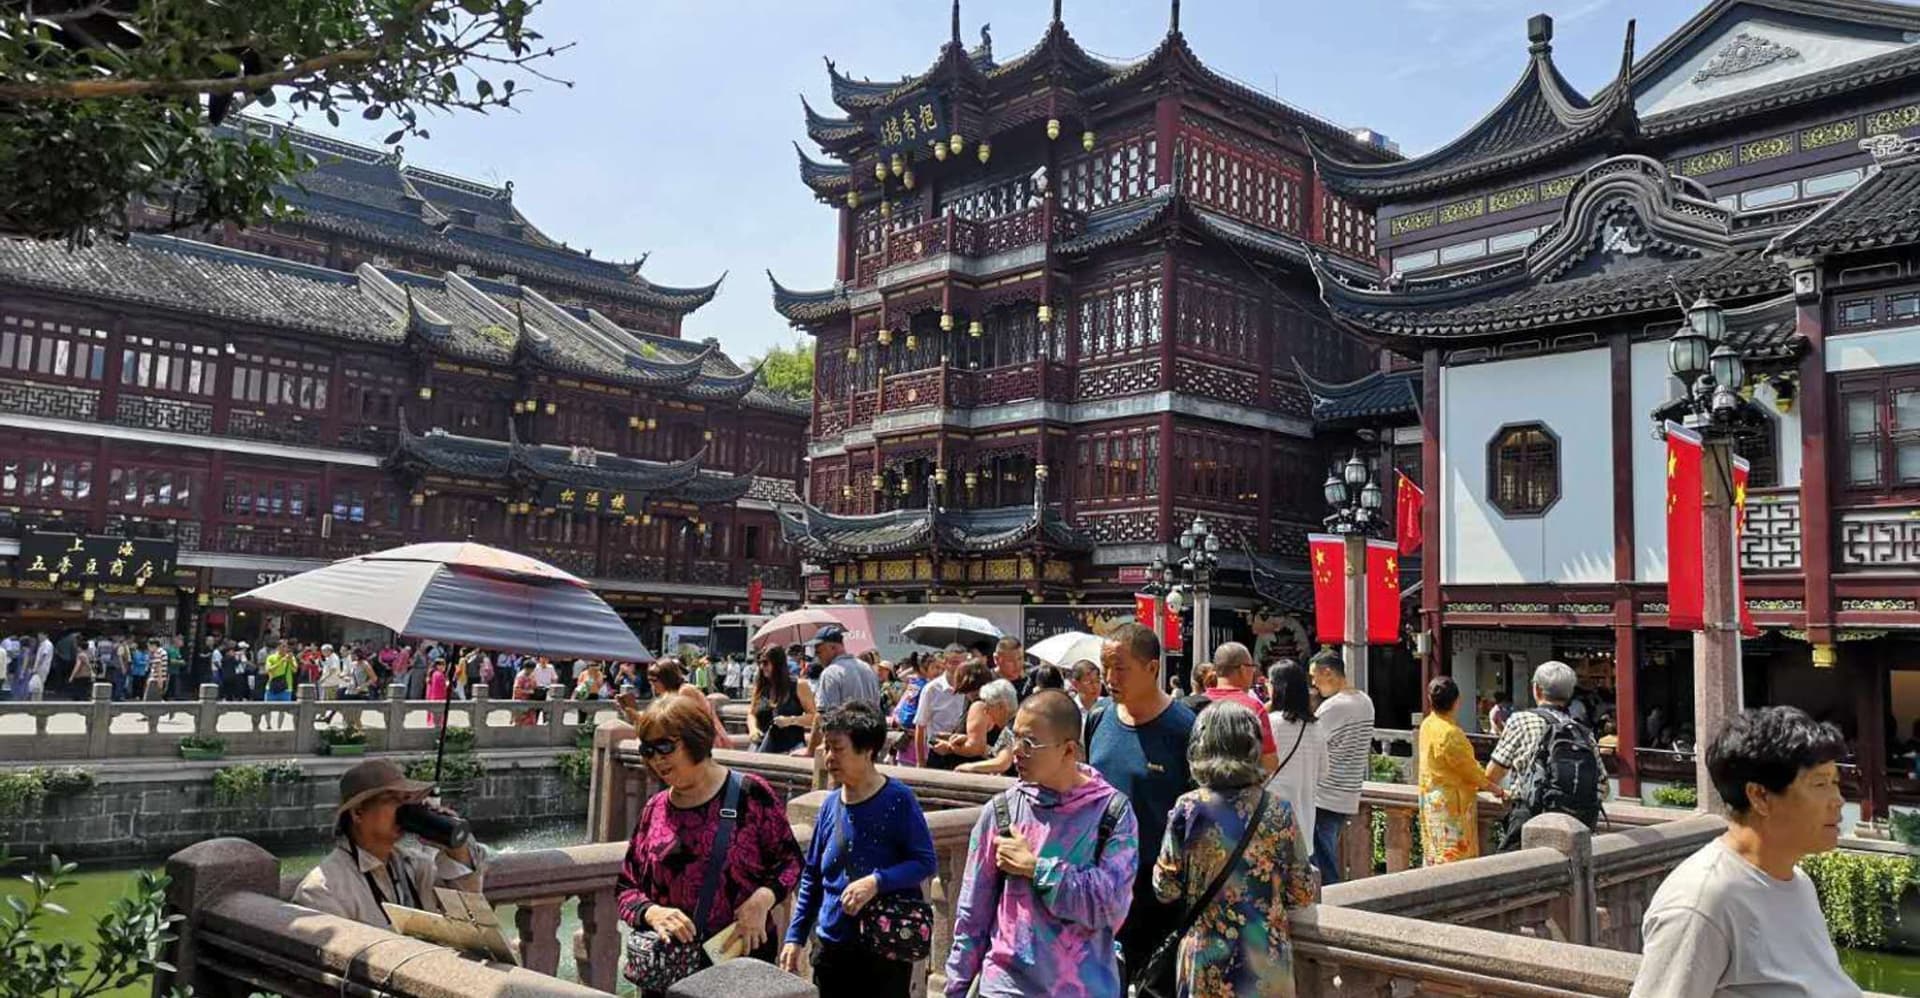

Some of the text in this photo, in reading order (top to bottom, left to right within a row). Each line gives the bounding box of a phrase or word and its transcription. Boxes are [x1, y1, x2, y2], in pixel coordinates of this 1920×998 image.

[66, 537, 134, 557] 上海
[26, 555, 153, 578] 五香豆商店
